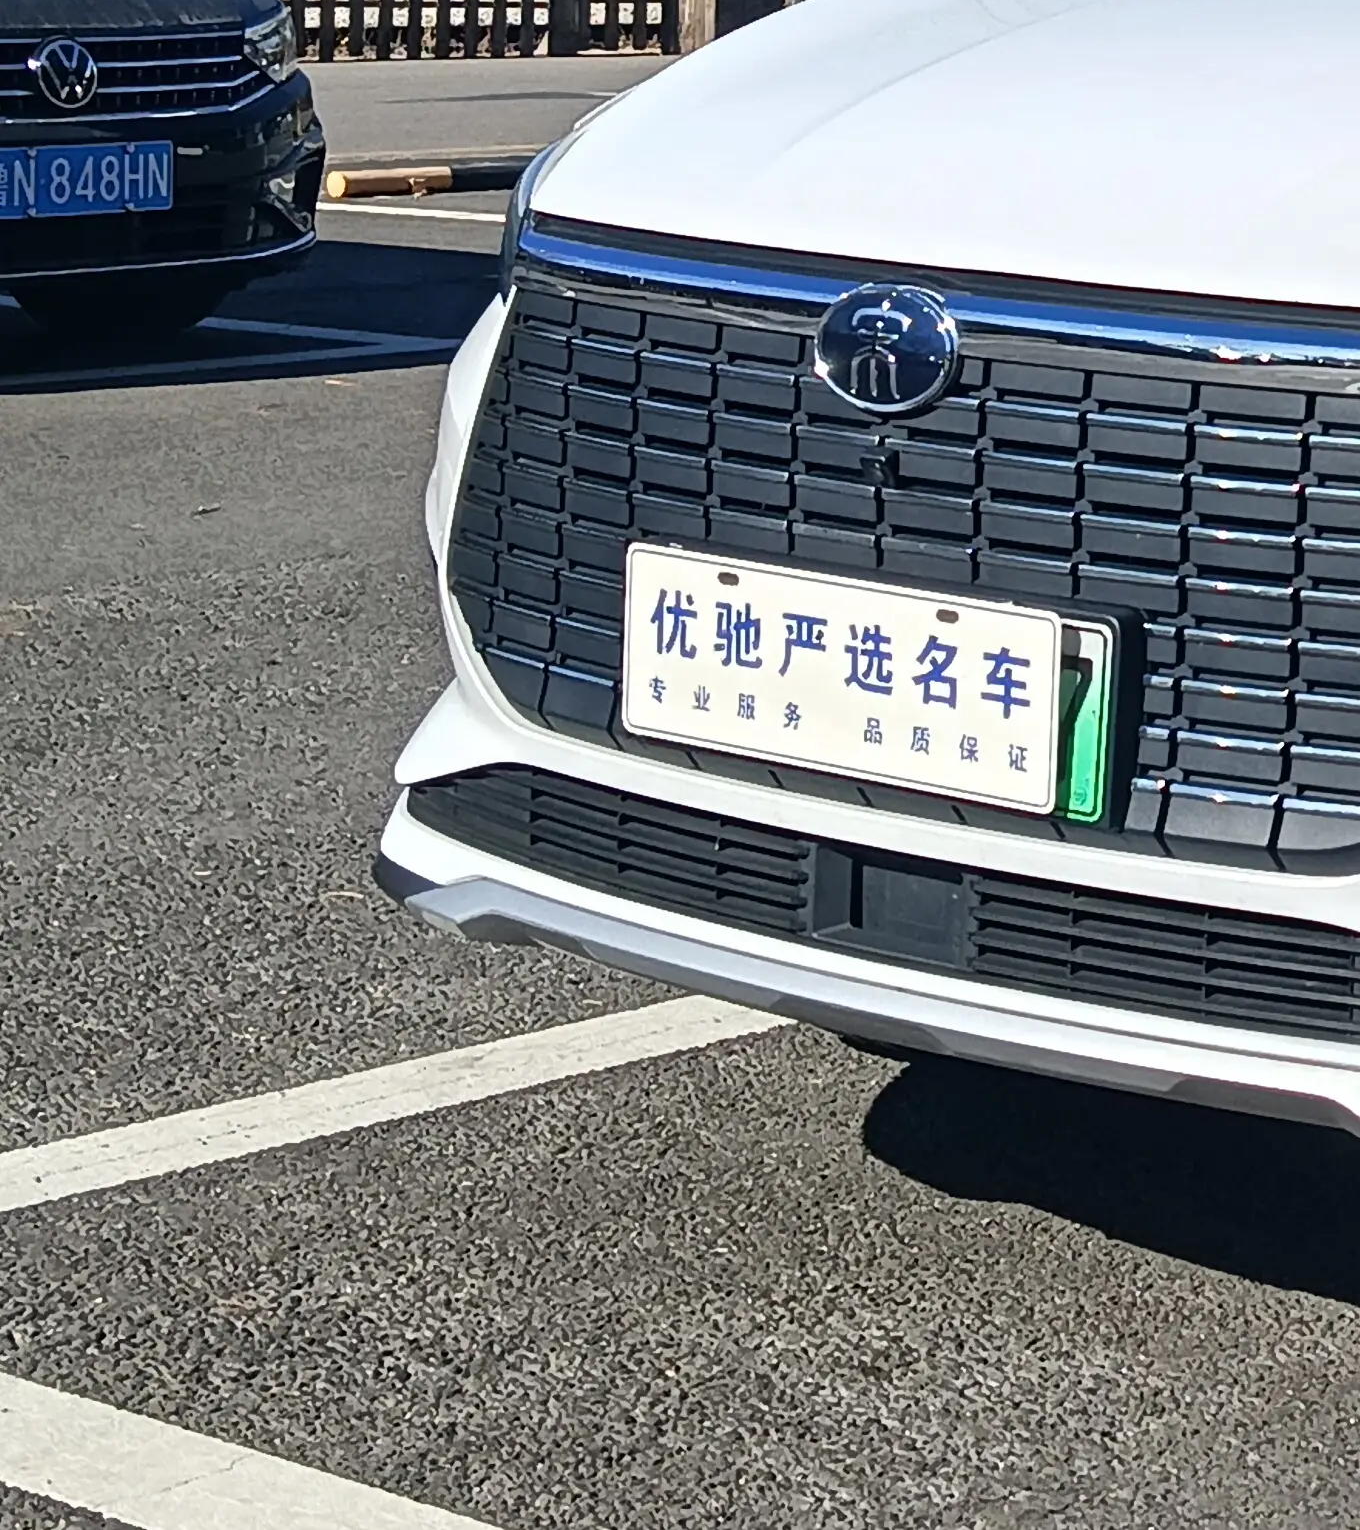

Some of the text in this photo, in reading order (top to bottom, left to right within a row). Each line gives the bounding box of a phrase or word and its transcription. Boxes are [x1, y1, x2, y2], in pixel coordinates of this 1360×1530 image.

[650, 587, 1031, 720] 优驰严选名车
[648, 676, 1029, 773] 专业服务 品质保证
